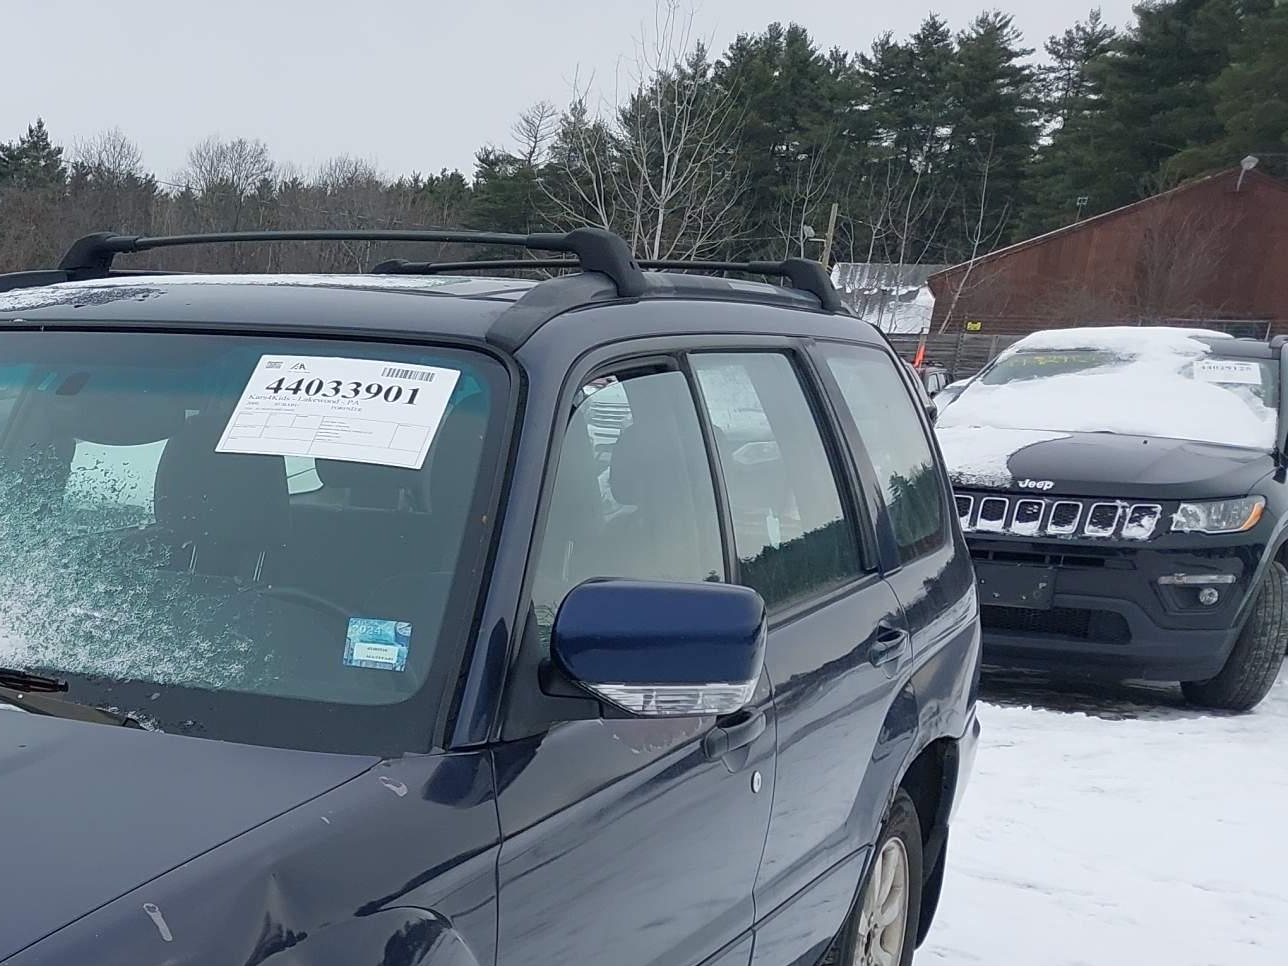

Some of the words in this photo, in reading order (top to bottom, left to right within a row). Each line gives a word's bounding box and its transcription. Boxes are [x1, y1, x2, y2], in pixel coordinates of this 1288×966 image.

[265, 376, 420, 406] 44033901
[1017, 478, 1055, 491] Jeep
[352, 624, 383, 636] 2024
